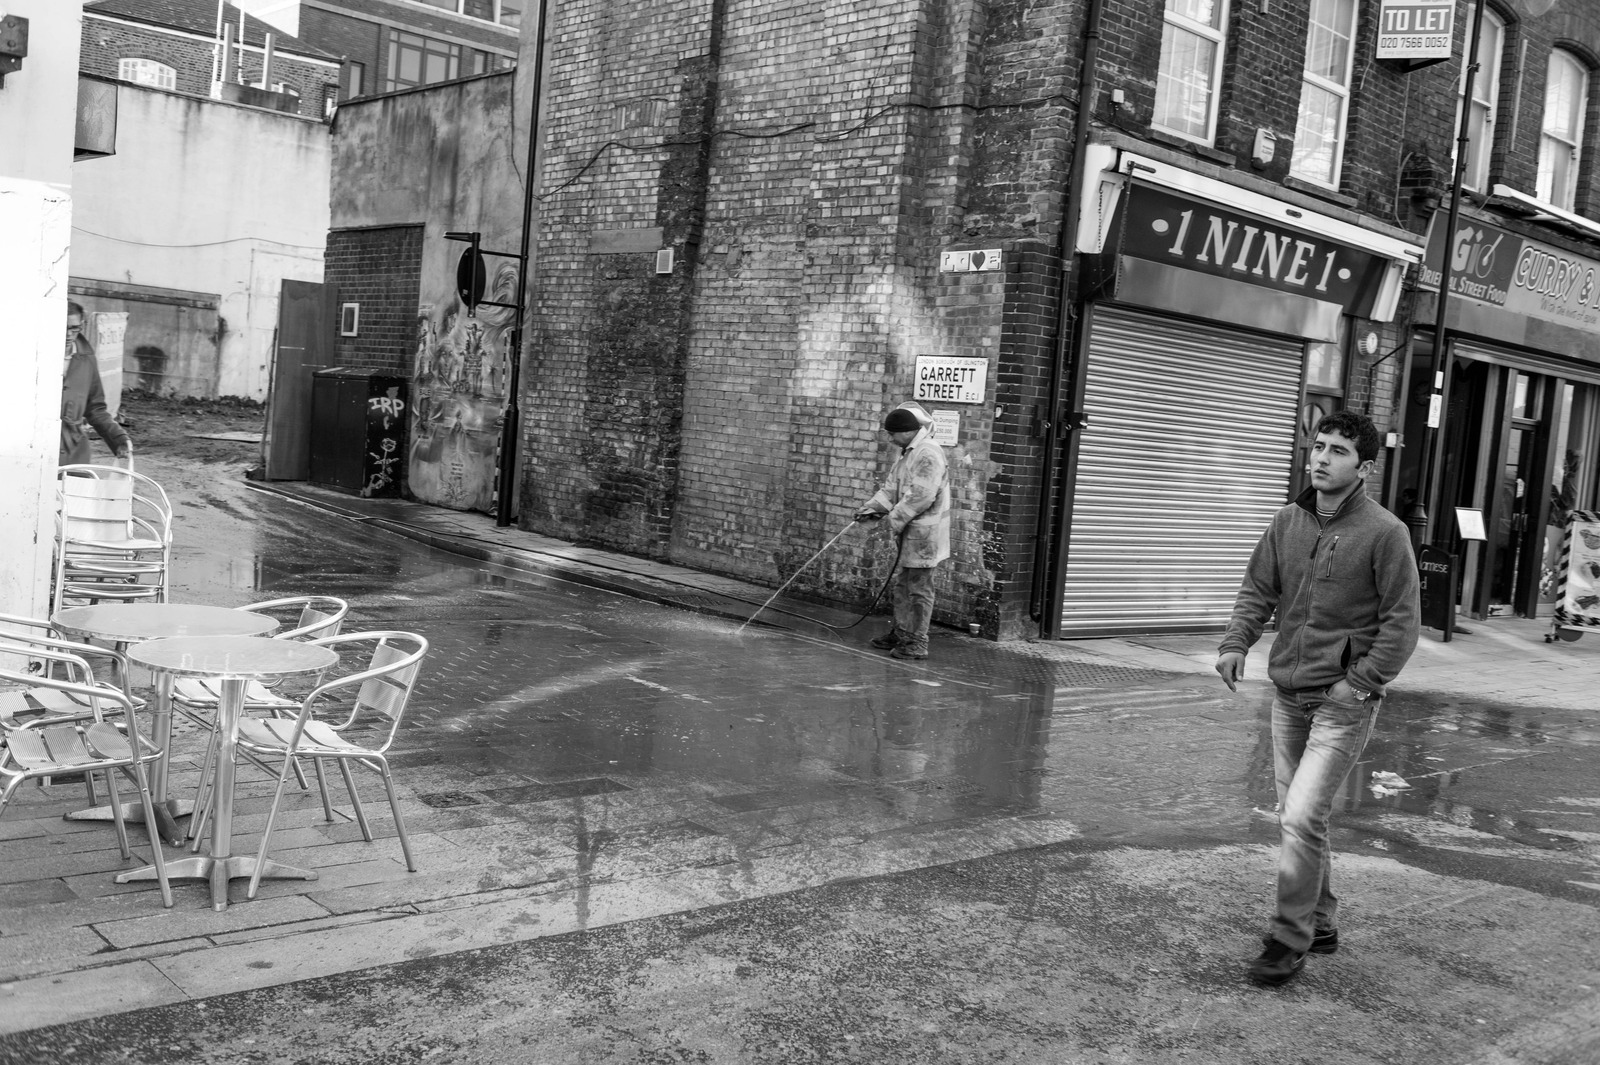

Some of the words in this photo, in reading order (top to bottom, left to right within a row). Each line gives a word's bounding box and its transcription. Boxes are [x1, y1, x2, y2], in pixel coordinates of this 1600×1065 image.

[1385, 9, 1410, 31] TO
[1414, 8, 1450, 31] LET
[1380, 37, 1398, 49] 020
[1401, 37, 1423, 48] 7566
[1425, 36, 1448, 48] 0052
[1195, 214, 1316, 286] NINE
[1514, 245, 1583, 303] CURRY
[1458, 276, 1488, 298] STREET
[921, 366, 976, 383] GARRETT
[919, 382, 963, 399] STREET
